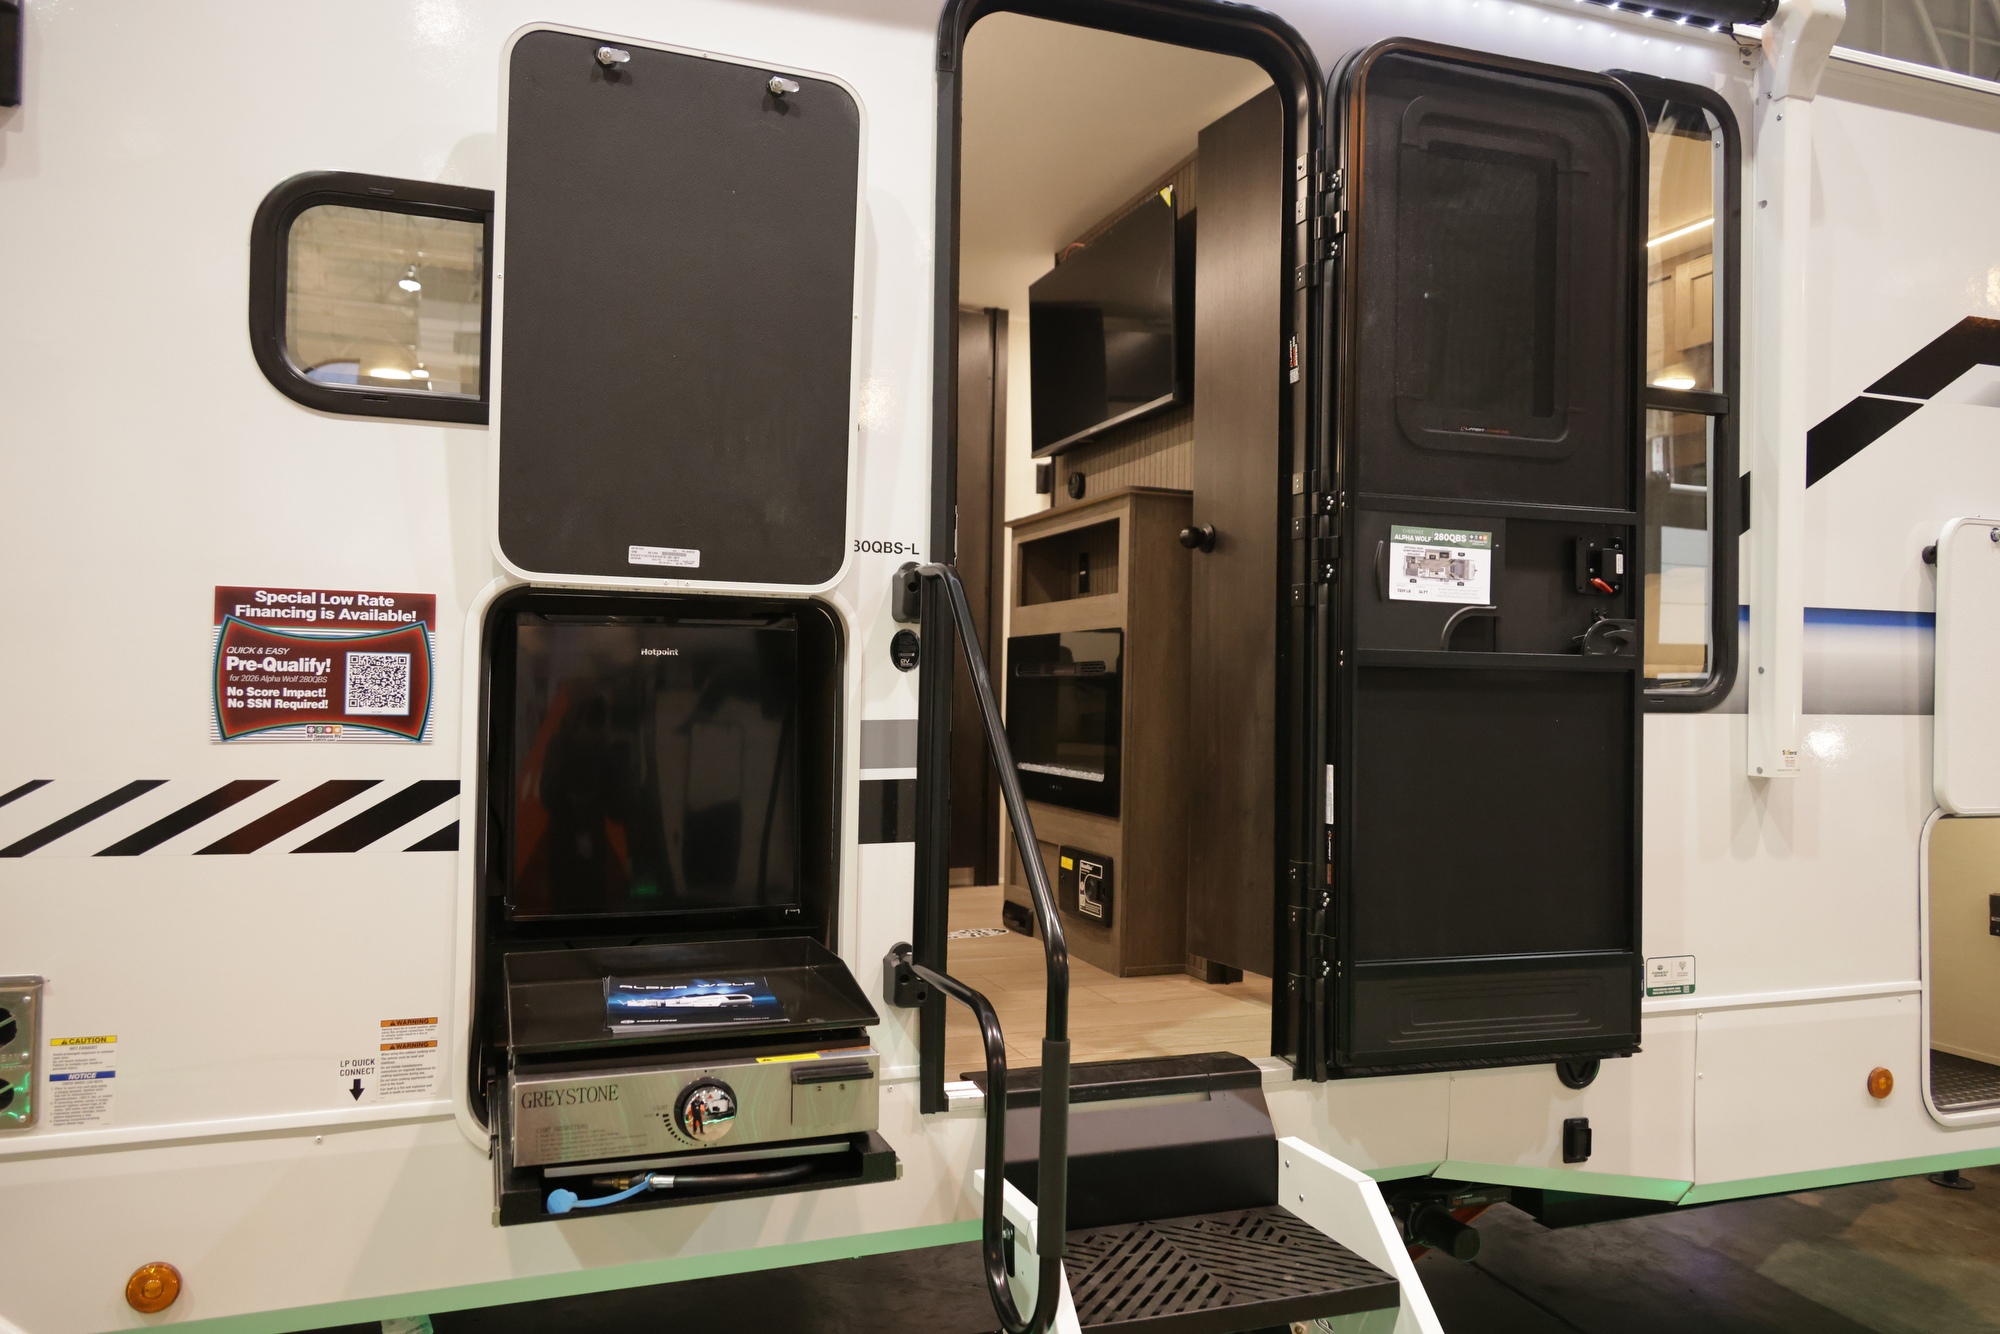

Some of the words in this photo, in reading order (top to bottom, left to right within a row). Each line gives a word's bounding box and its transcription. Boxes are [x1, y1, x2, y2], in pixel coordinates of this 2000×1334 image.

[1434, 532, 1467, 543] 280QBS
[255, 590, 316, 605] Special
[320, 592, 354, 605] Low
[358, 594, 394, 606] Rate
[235, 604, 316, 622] Financing
[320, 607, 335, 619] is
[338, 608, 416, 622] Available!
[226, 646, 256, 654] QUICK
[641, 648, 679, 656] Hotpoint
[226, 656, 331, 675] Pre-Qualify!
[260, 675, 280, 683] Alpha
[227, 686, 243, 696] No
[246, 687, 280, 696] Score
[282, 687, 326, 699] Impact!
[228, 698, 244, 708] No
[247, 699, 271, 708] SSN
[274, 699, 328, 710] Required!
[397, 1018, 429, 1026] WARNING
[352, 1058, 375, 1067] QUICK
[68, 1072, 97, 1080] NOTICE
[340, 1067, 375, 1076] CONNECT
[522, 1084, 619, 1109] GREYSTONE
